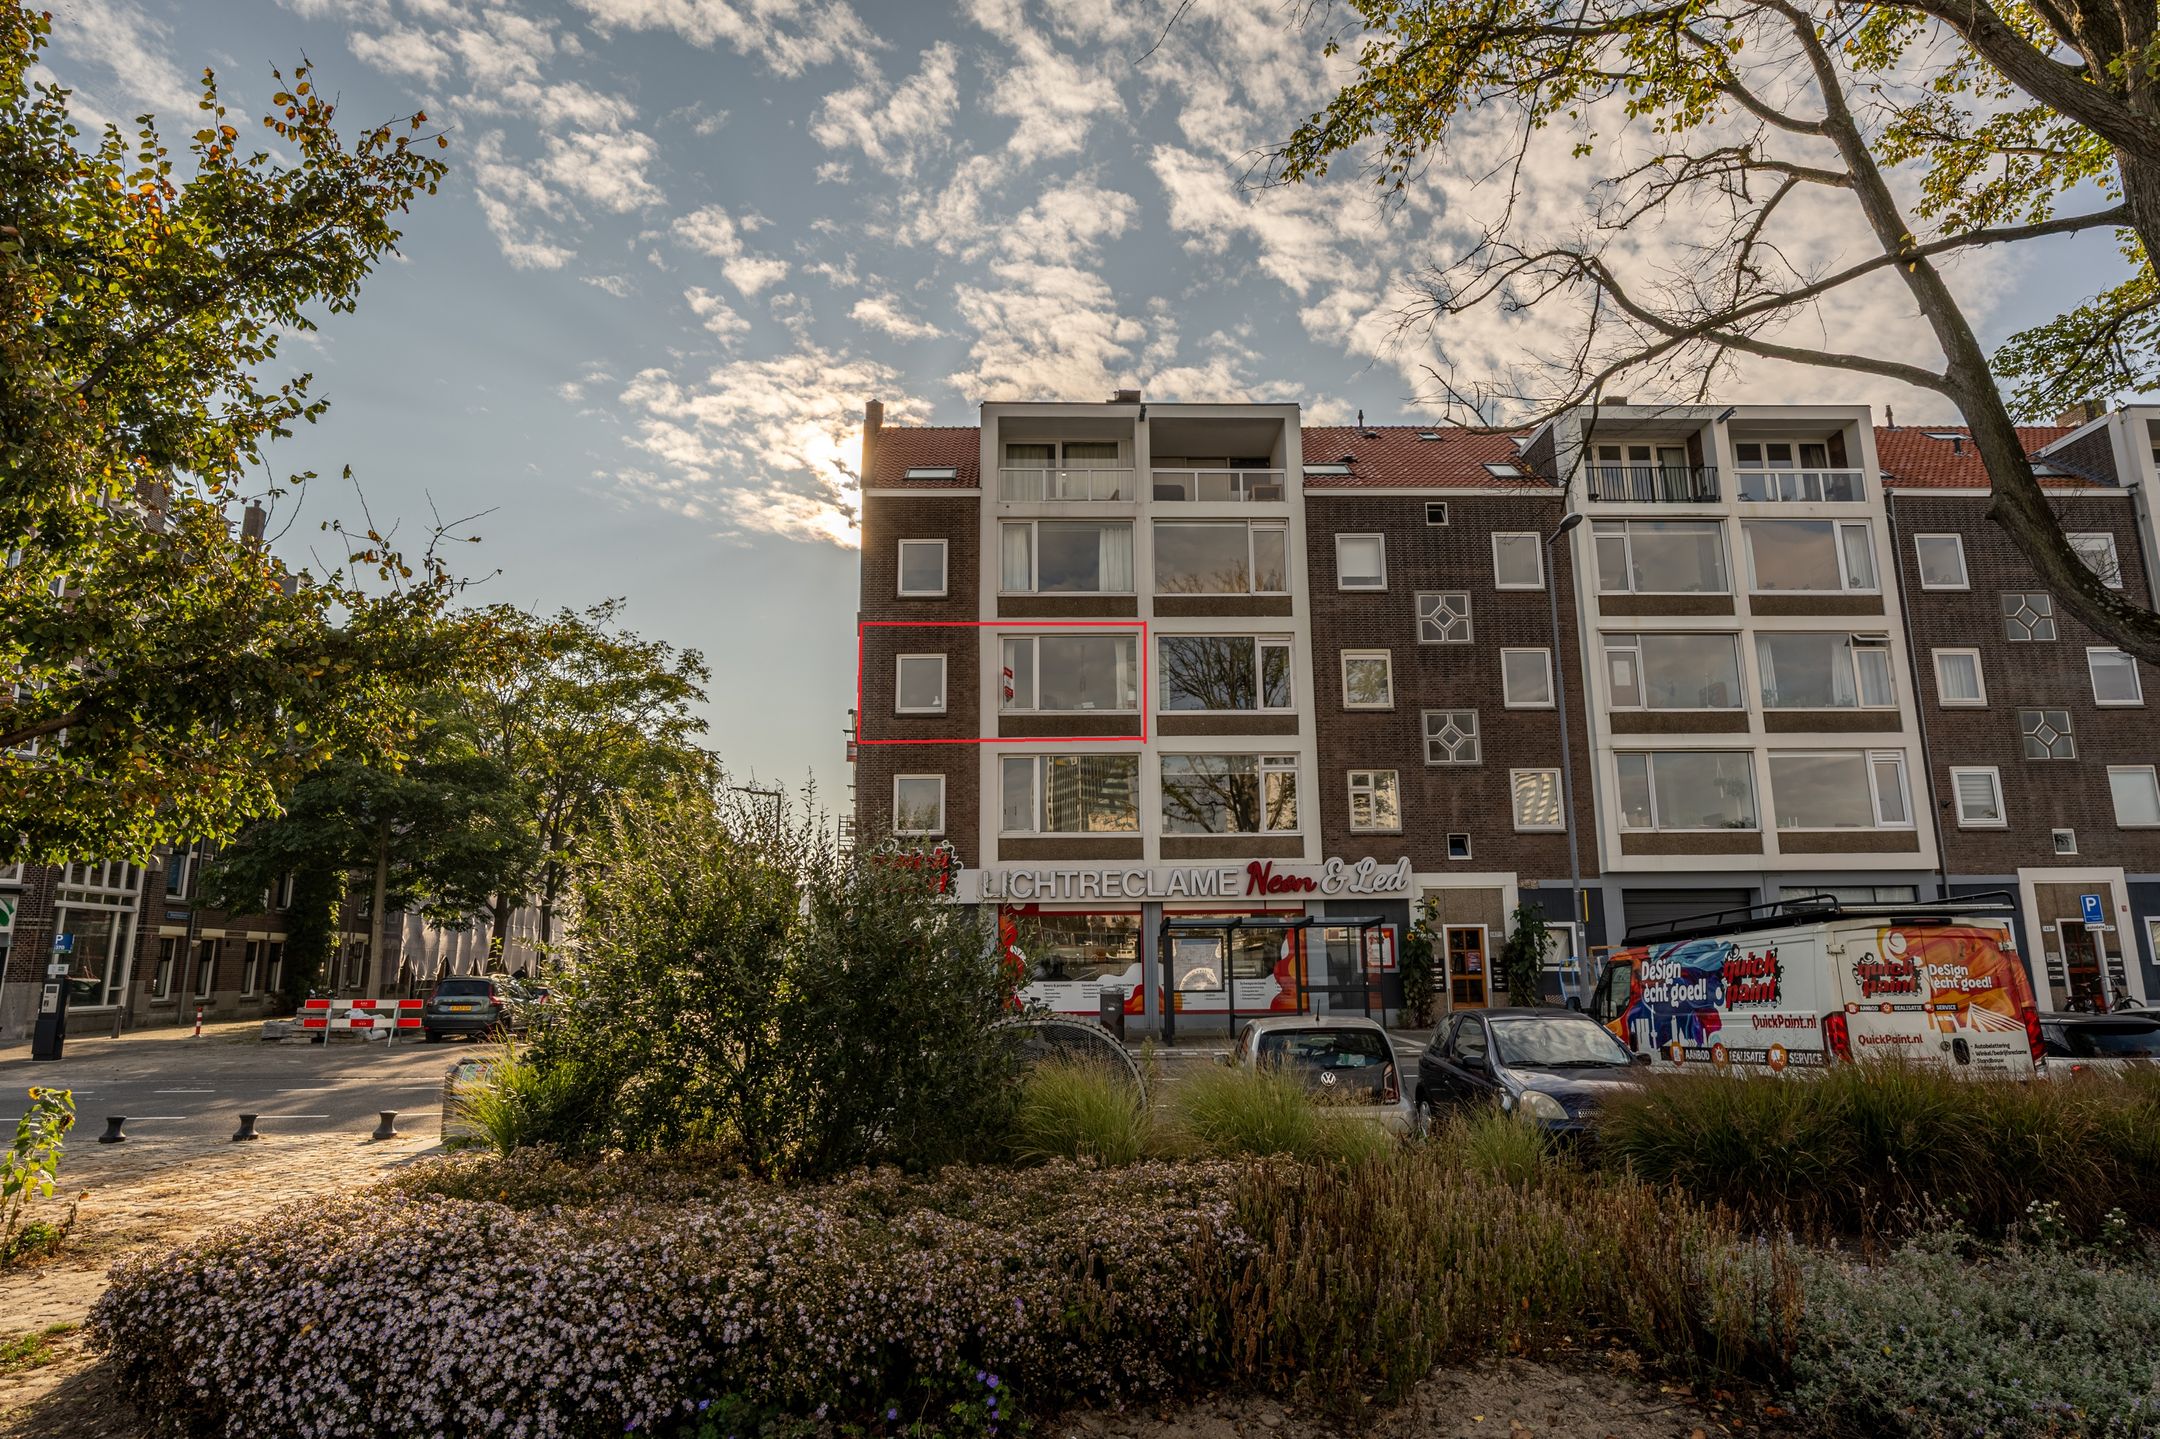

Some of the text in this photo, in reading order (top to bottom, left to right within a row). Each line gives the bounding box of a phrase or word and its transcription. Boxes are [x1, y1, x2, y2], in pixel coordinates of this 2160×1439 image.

[982, 868, 1240, 899] LICHTRECLAME
[1246, 860, 1318, 896] Neon
[1321, 859, 1348, 896] &
[1349, 856, 1408, 895] Led
[2085, 897, 2097, 912] P
[55, 934, 64, 945] P
[1641, 960, 1682, 985] DeSign
[1723, 950, 1777, 984] quick
[1928, 963, 1969, 979] DeSign
[1726, 975, 1777, 1009] paint
[1960, 975, 1993, 992] goed!
[1670, 978, 1707, 1008] goed!
[1751, 1014, 1817, 1031] QuickPaint.nl
[1858, 1034, 1923, 1046] QuickPaint.nl
